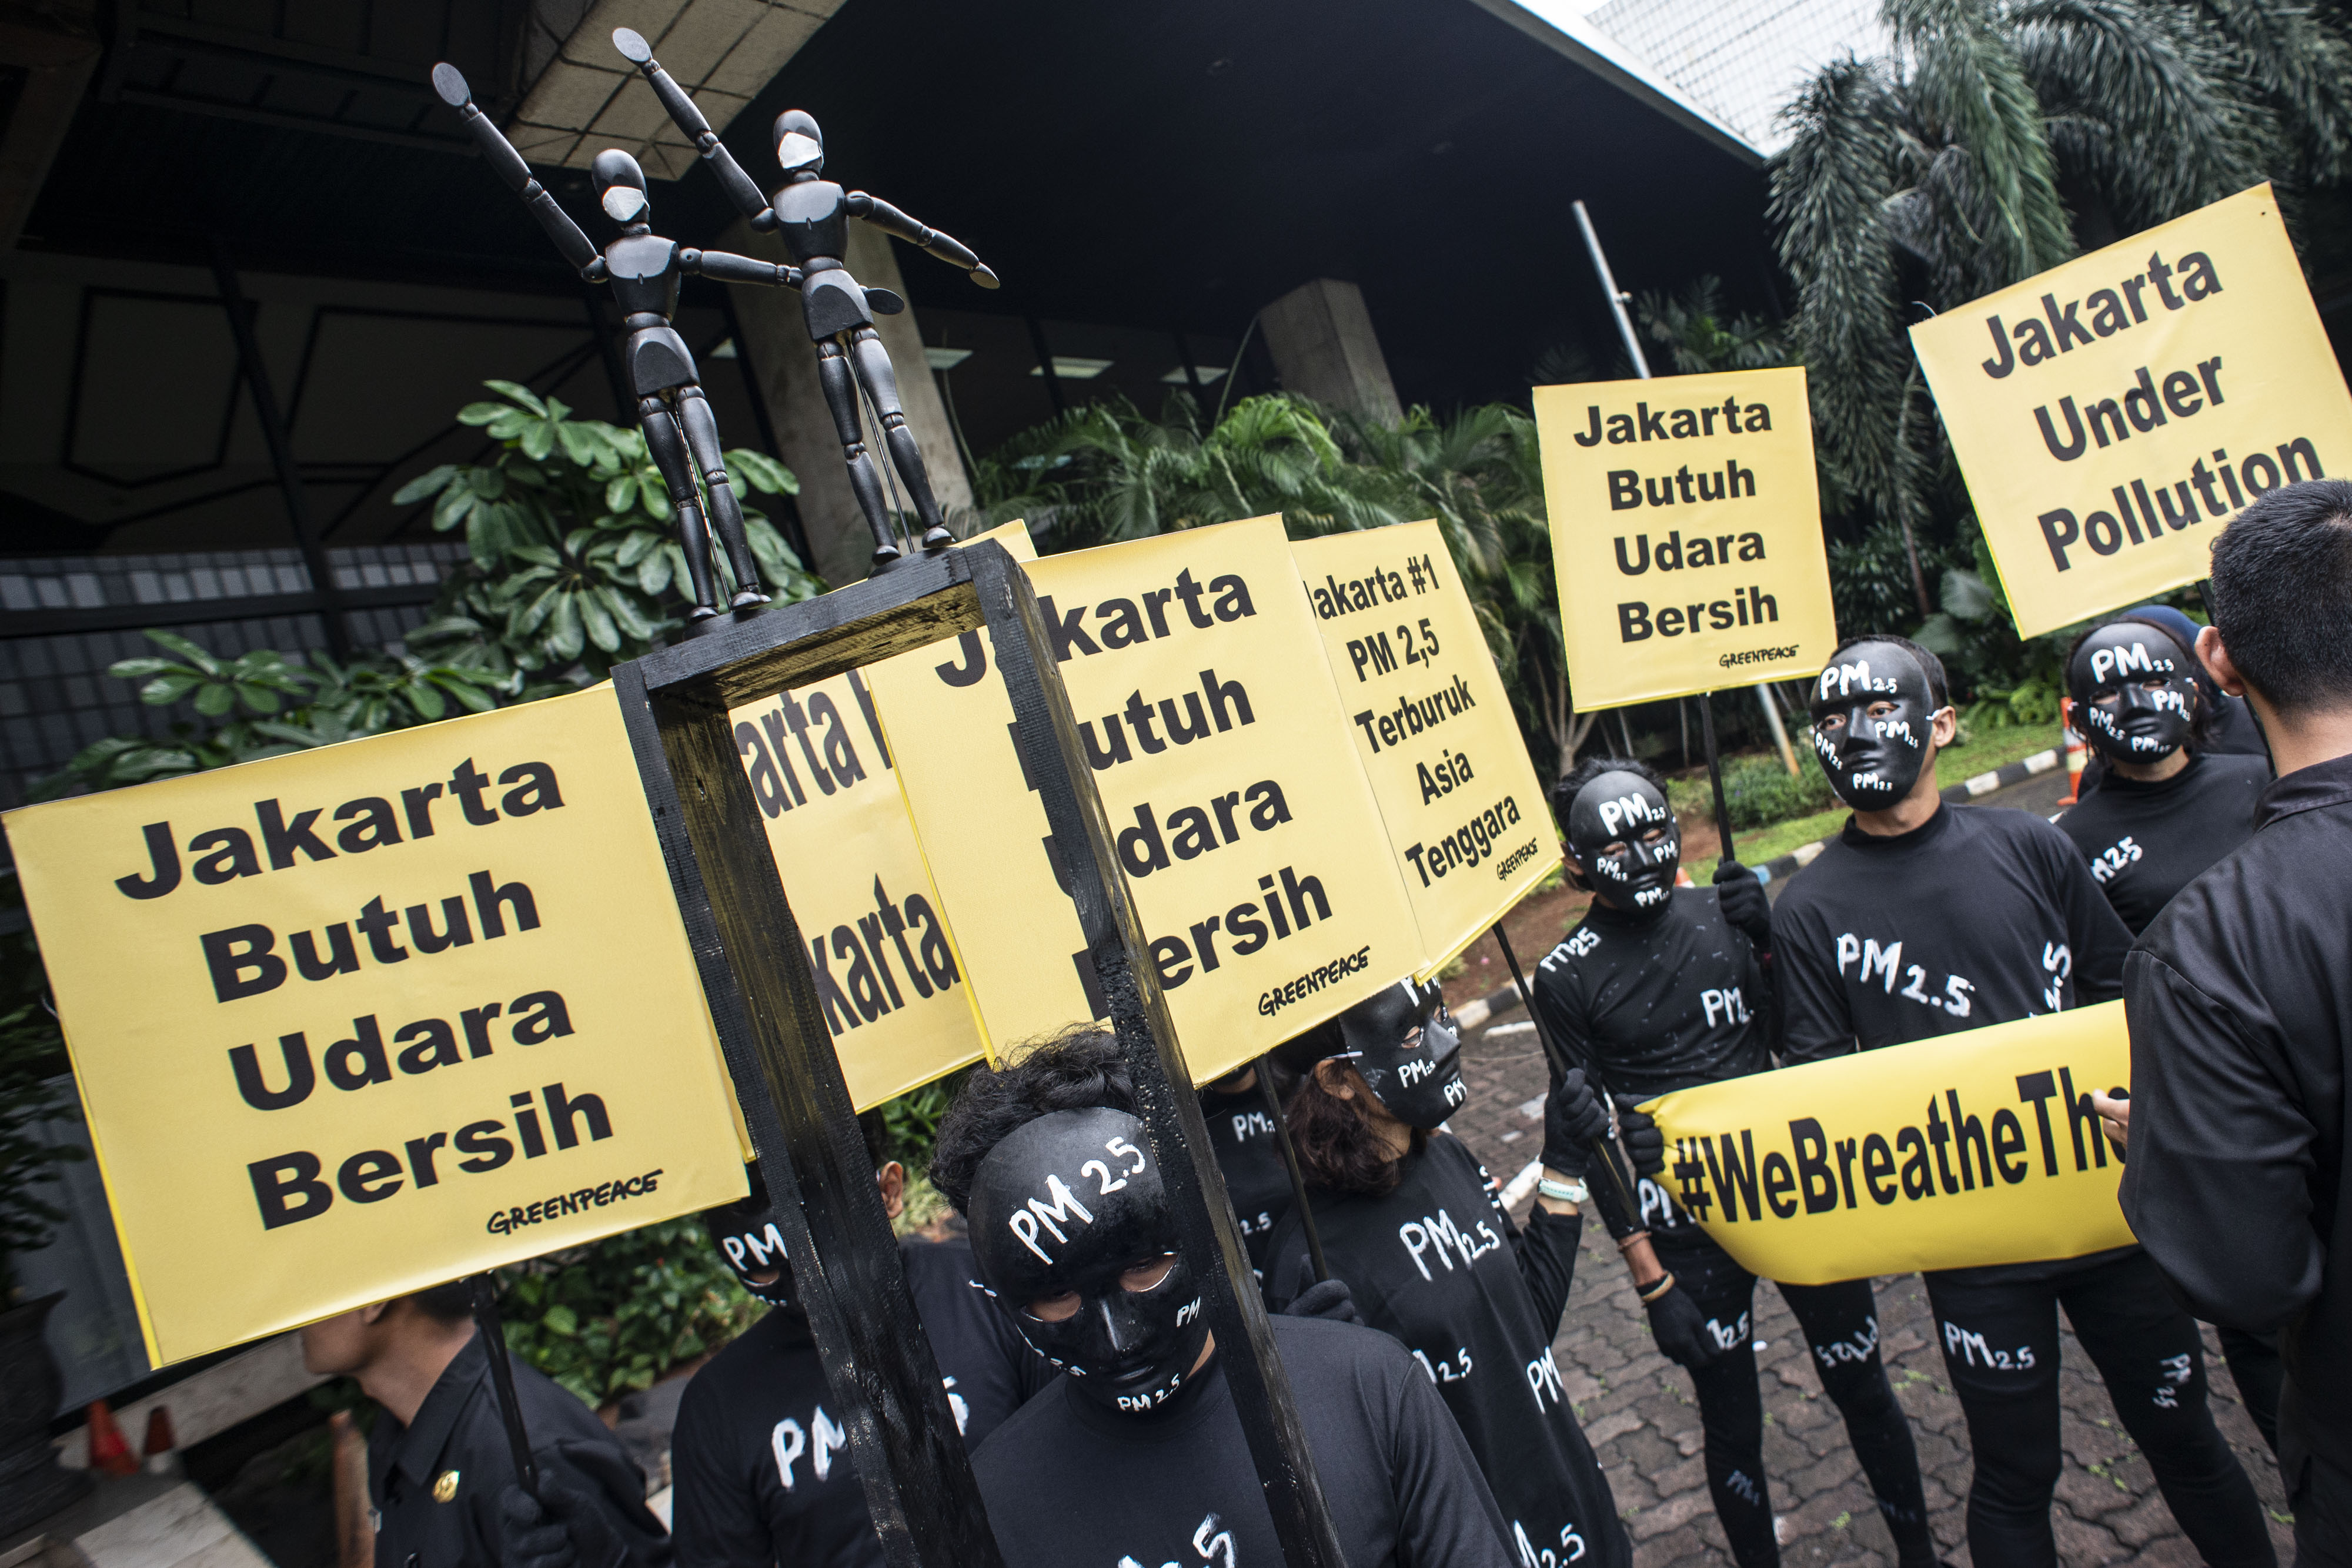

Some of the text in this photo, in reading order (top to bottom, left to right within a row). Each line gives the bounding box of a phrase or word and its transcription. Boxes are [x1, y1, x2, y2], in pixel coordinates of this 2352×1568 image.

[1982, 250, 2223, 379] Jakarta
[1573, 396, 1772, 447] Jakarta
[2033, 356, 2224, 462] Under
[1607, 459, 1756, 511] Butuh
[2037, 436, 2326, 573] Pollution
[1407, 554, 1440, 594] #1
[1613, 531, 1766, 576] Udara
[935, 567, 1257, 688] Jkarta
[1346, 618, 1440, 683] PM 2,5
[1618, 586, 1779, 643] Bersih
[1719, 645, 1799, 668] GREENPEACE
[733, 690, 867, 820] arta
[1007, 668, 1256, 792] utuh
[1354, 674, 1476, 754] Terburuk
[1416, 749, 1474, 806] Asia
[115, 757, 565, 900] Jakarta
[1404, 795, 1521, 888] Tenggara
[1496, 837, 1538, 881] GREENPEACE
[199, 870, 542, 1004] Butuh
[796, 872, 961, 1037] karta
[1071, 865, 1333, 1022] ersih
[1258, 945, 1371, 1017] GREENPEACE
[228, 989, 576, 1111] Udara
[246, 1082, 614, 1231] Bersih
[487, 1169, 663, 1236] GREENPEACE
